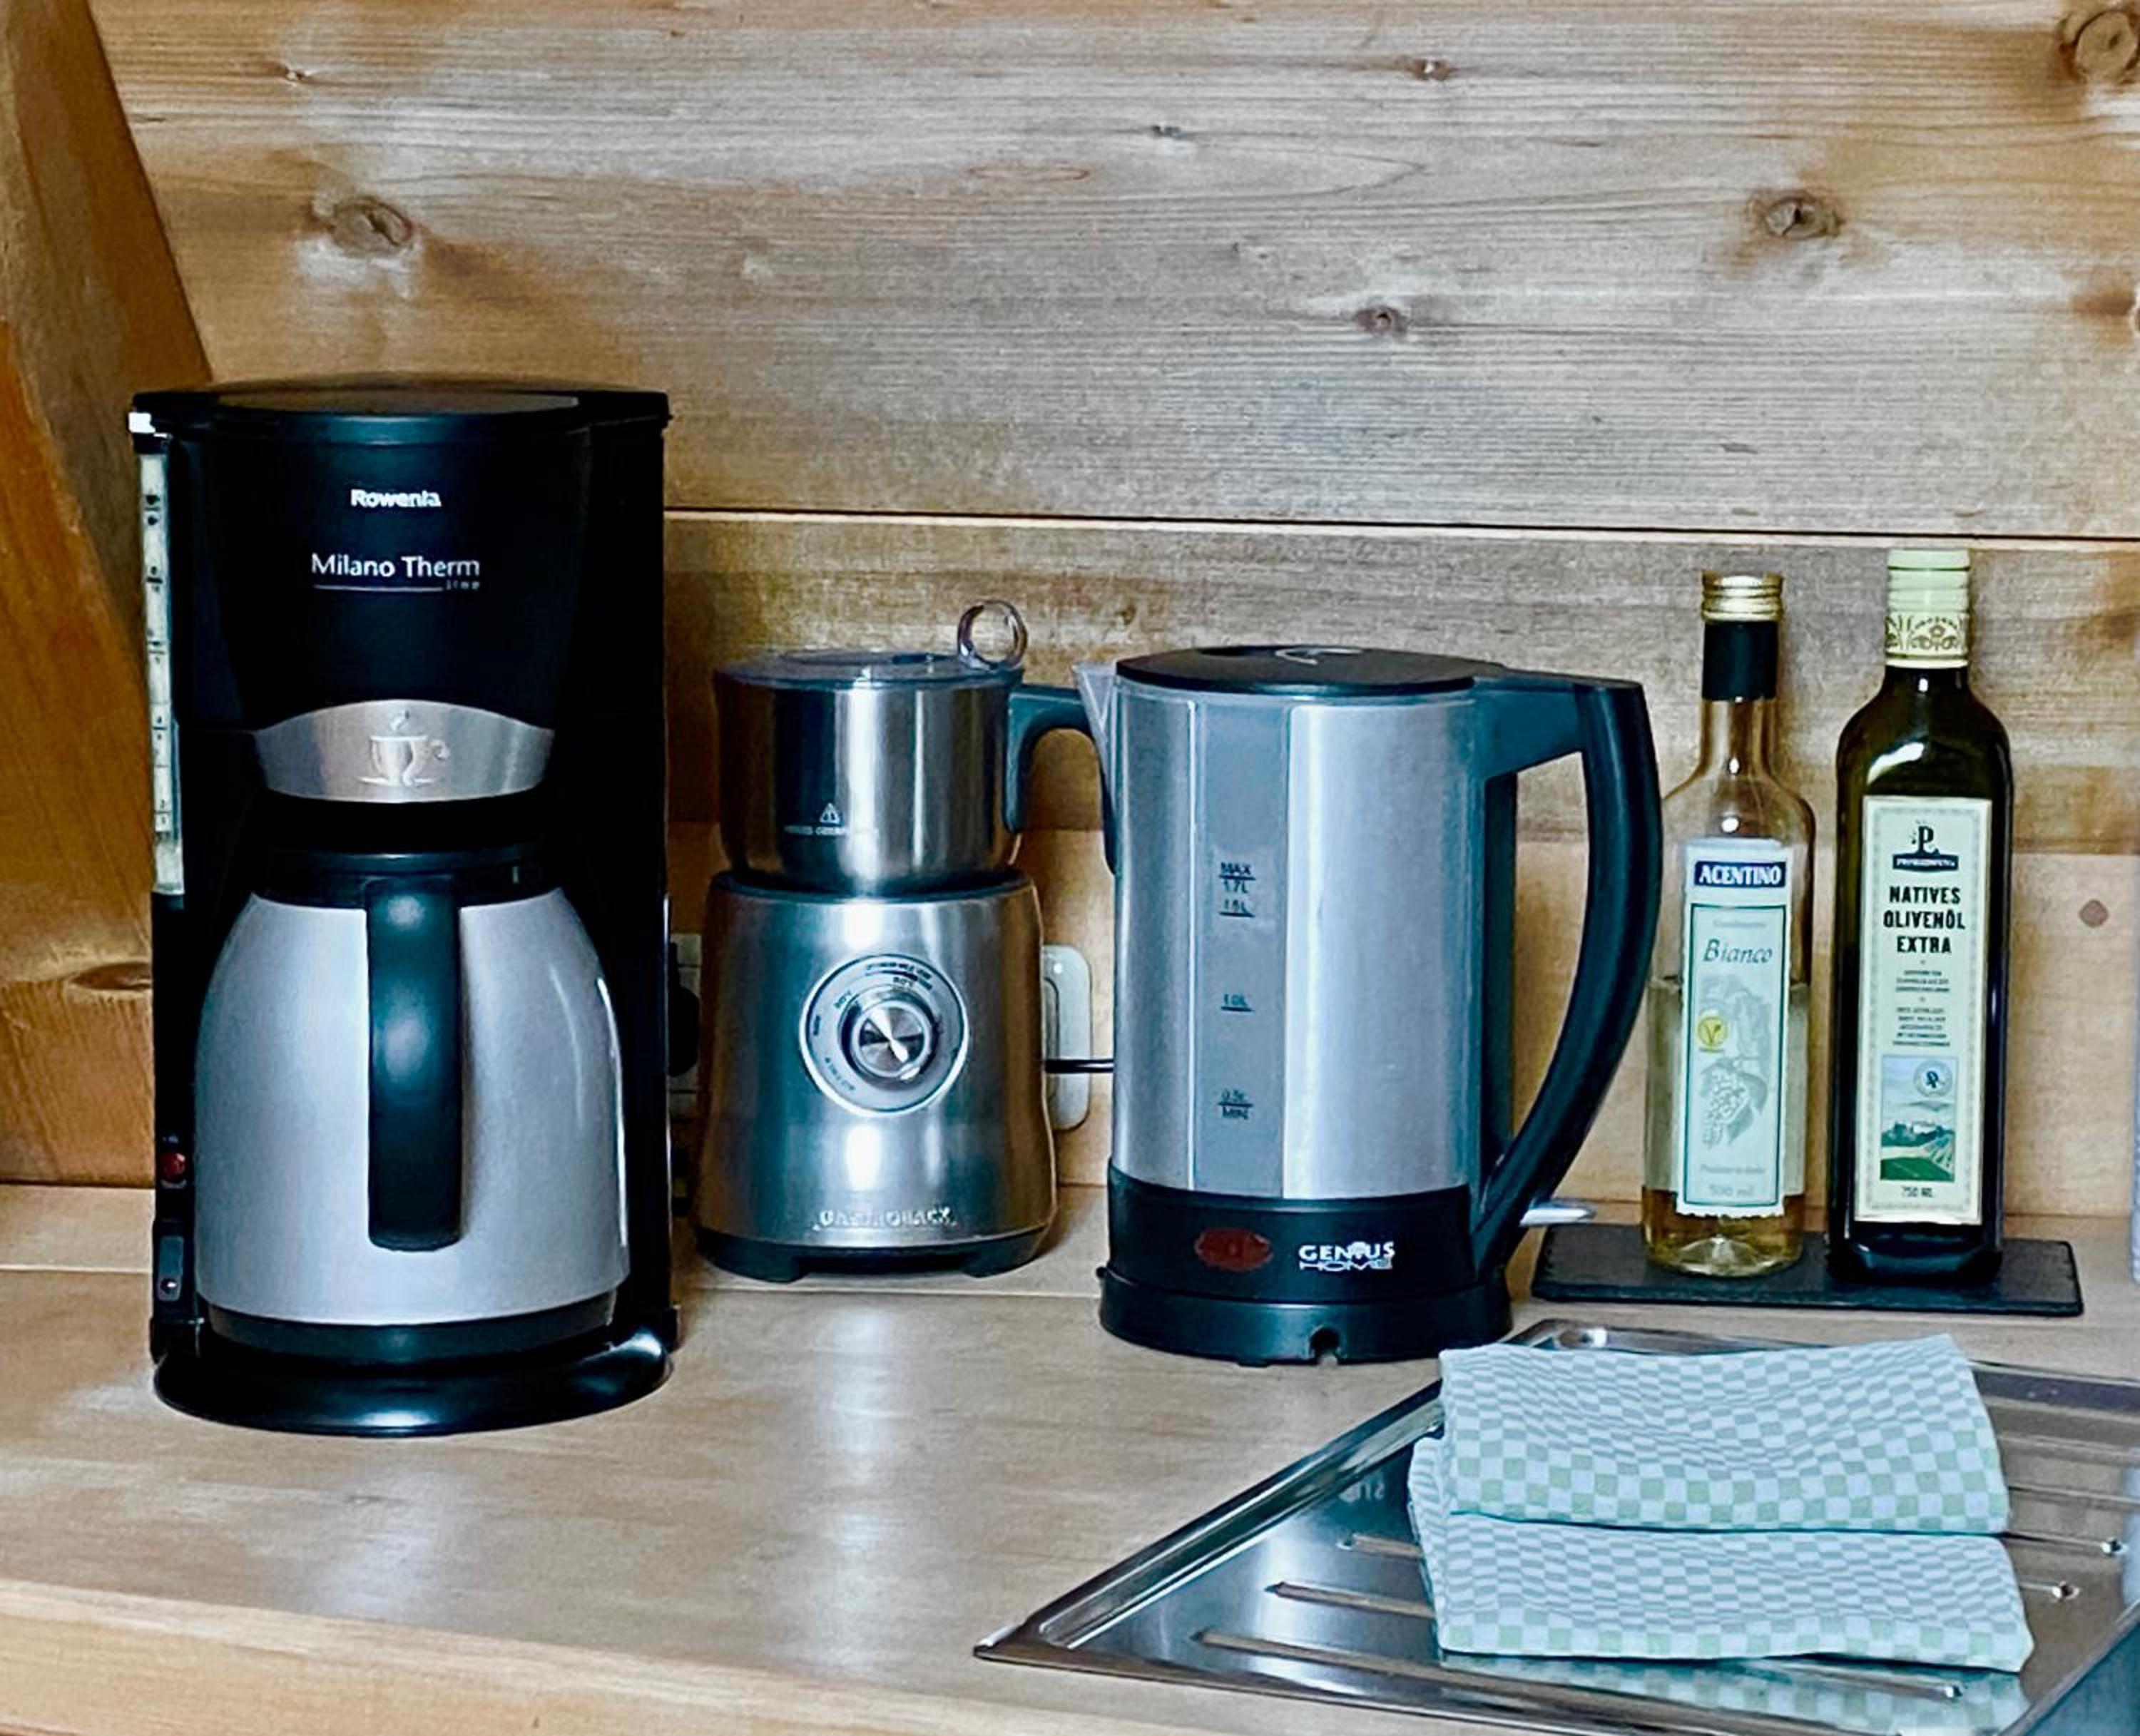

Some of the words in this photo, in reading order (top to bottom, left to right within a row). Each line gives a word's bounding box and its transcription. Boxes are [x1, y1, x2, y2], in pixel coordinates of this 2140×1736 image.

[350, 489, 442, 508] Rowenta
[311, 552, 396, 577] Milano
[401, 555, 480, 577] Therm
[1698, 864, 1782, 885] ACENTINO
[1890, 886, 1961, 904] NATIVES
[1703, 939, 1773, 964] Bianco
[1897, 935, 1952, 954] EXTRA
[1298, 1241, 1395, 1261] GENIUS
